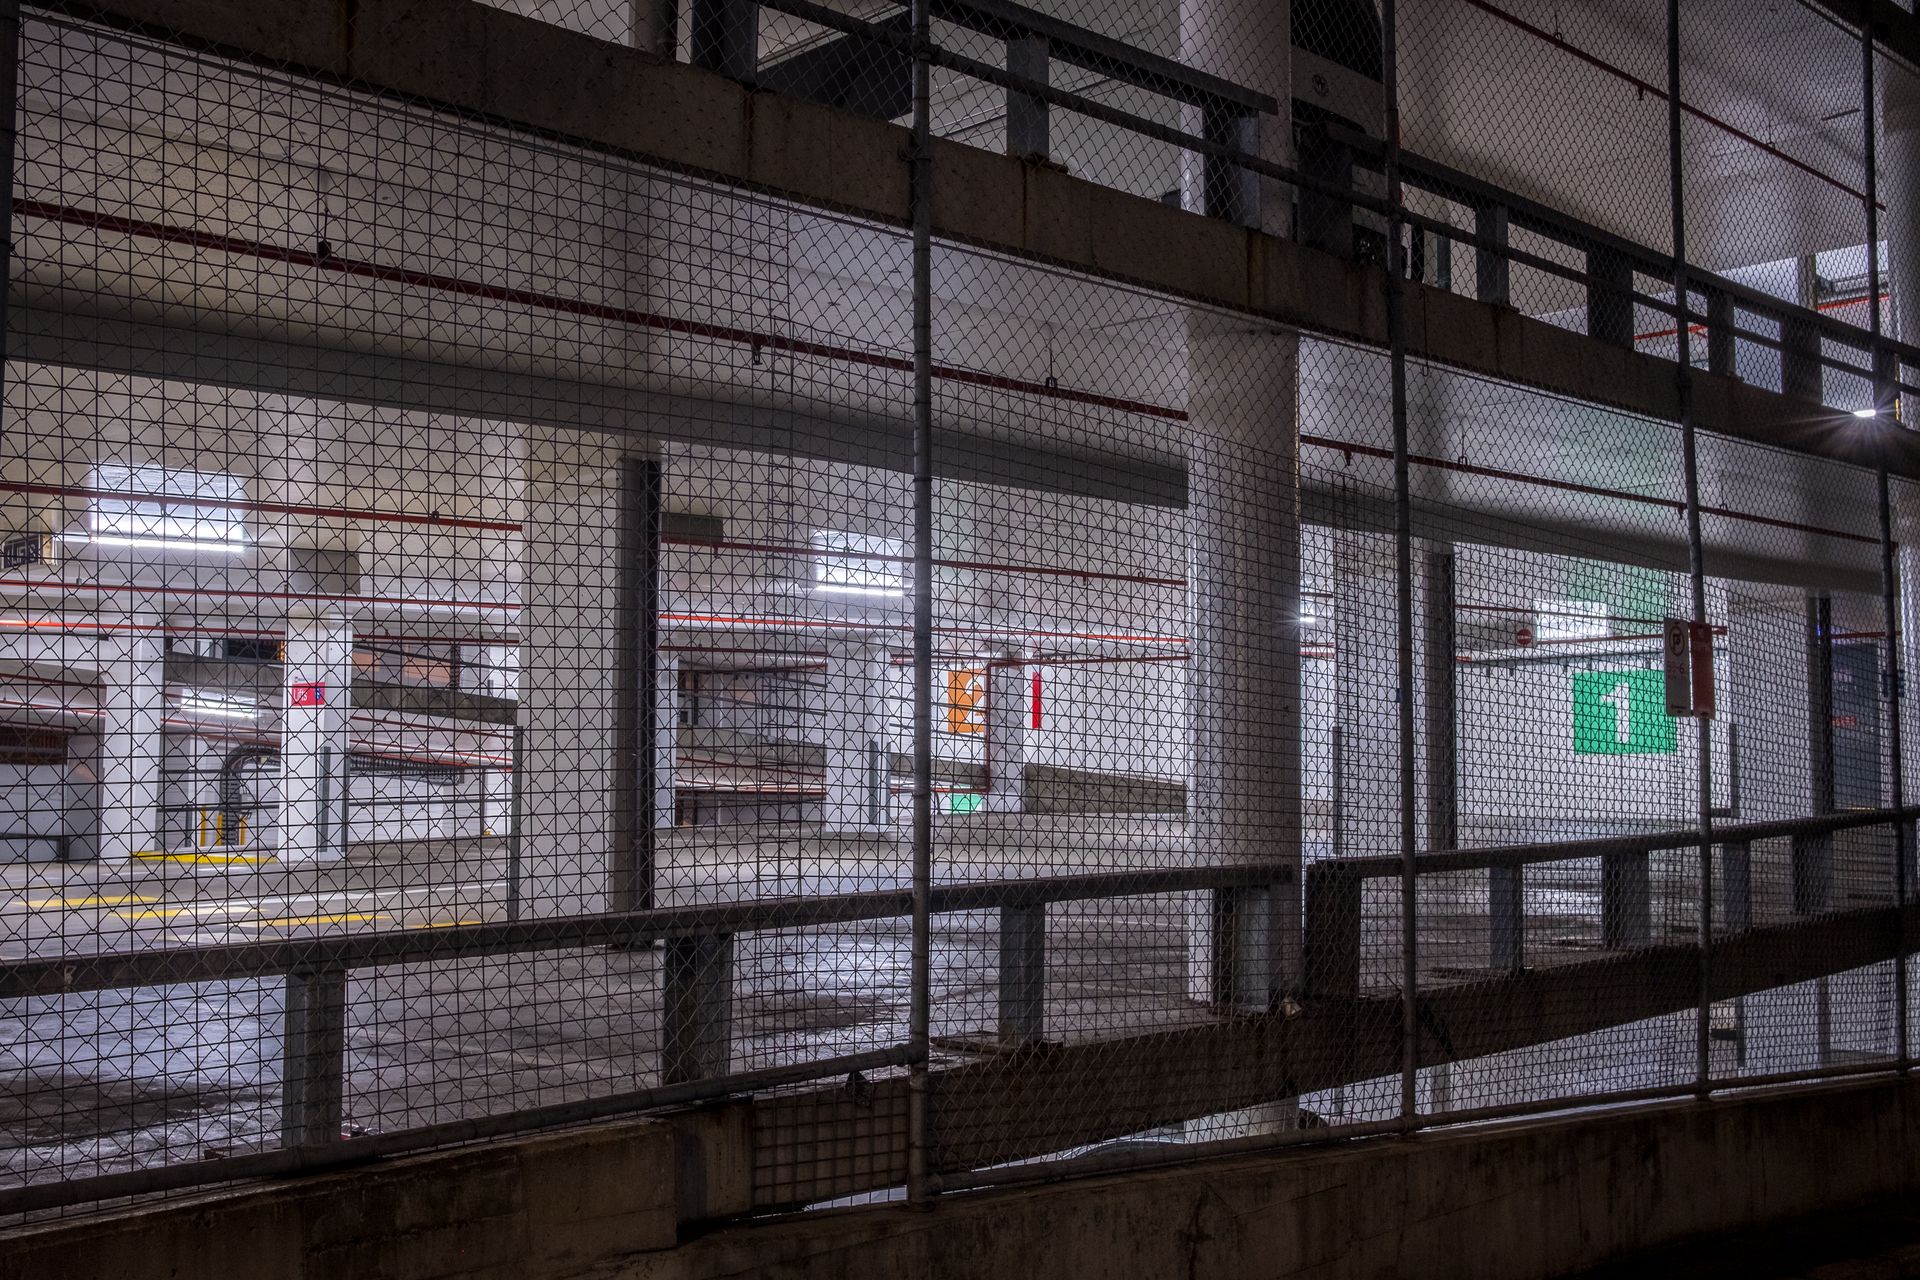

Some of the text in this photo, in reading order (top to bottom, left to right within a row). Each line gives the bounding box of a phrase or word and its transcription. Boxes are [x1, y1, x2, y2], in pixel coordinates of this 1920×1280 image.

[293, 688, 308, 702] Lifts
[965, 676, 986, 725] 2
[1600, 681, 1630, 744] 1
